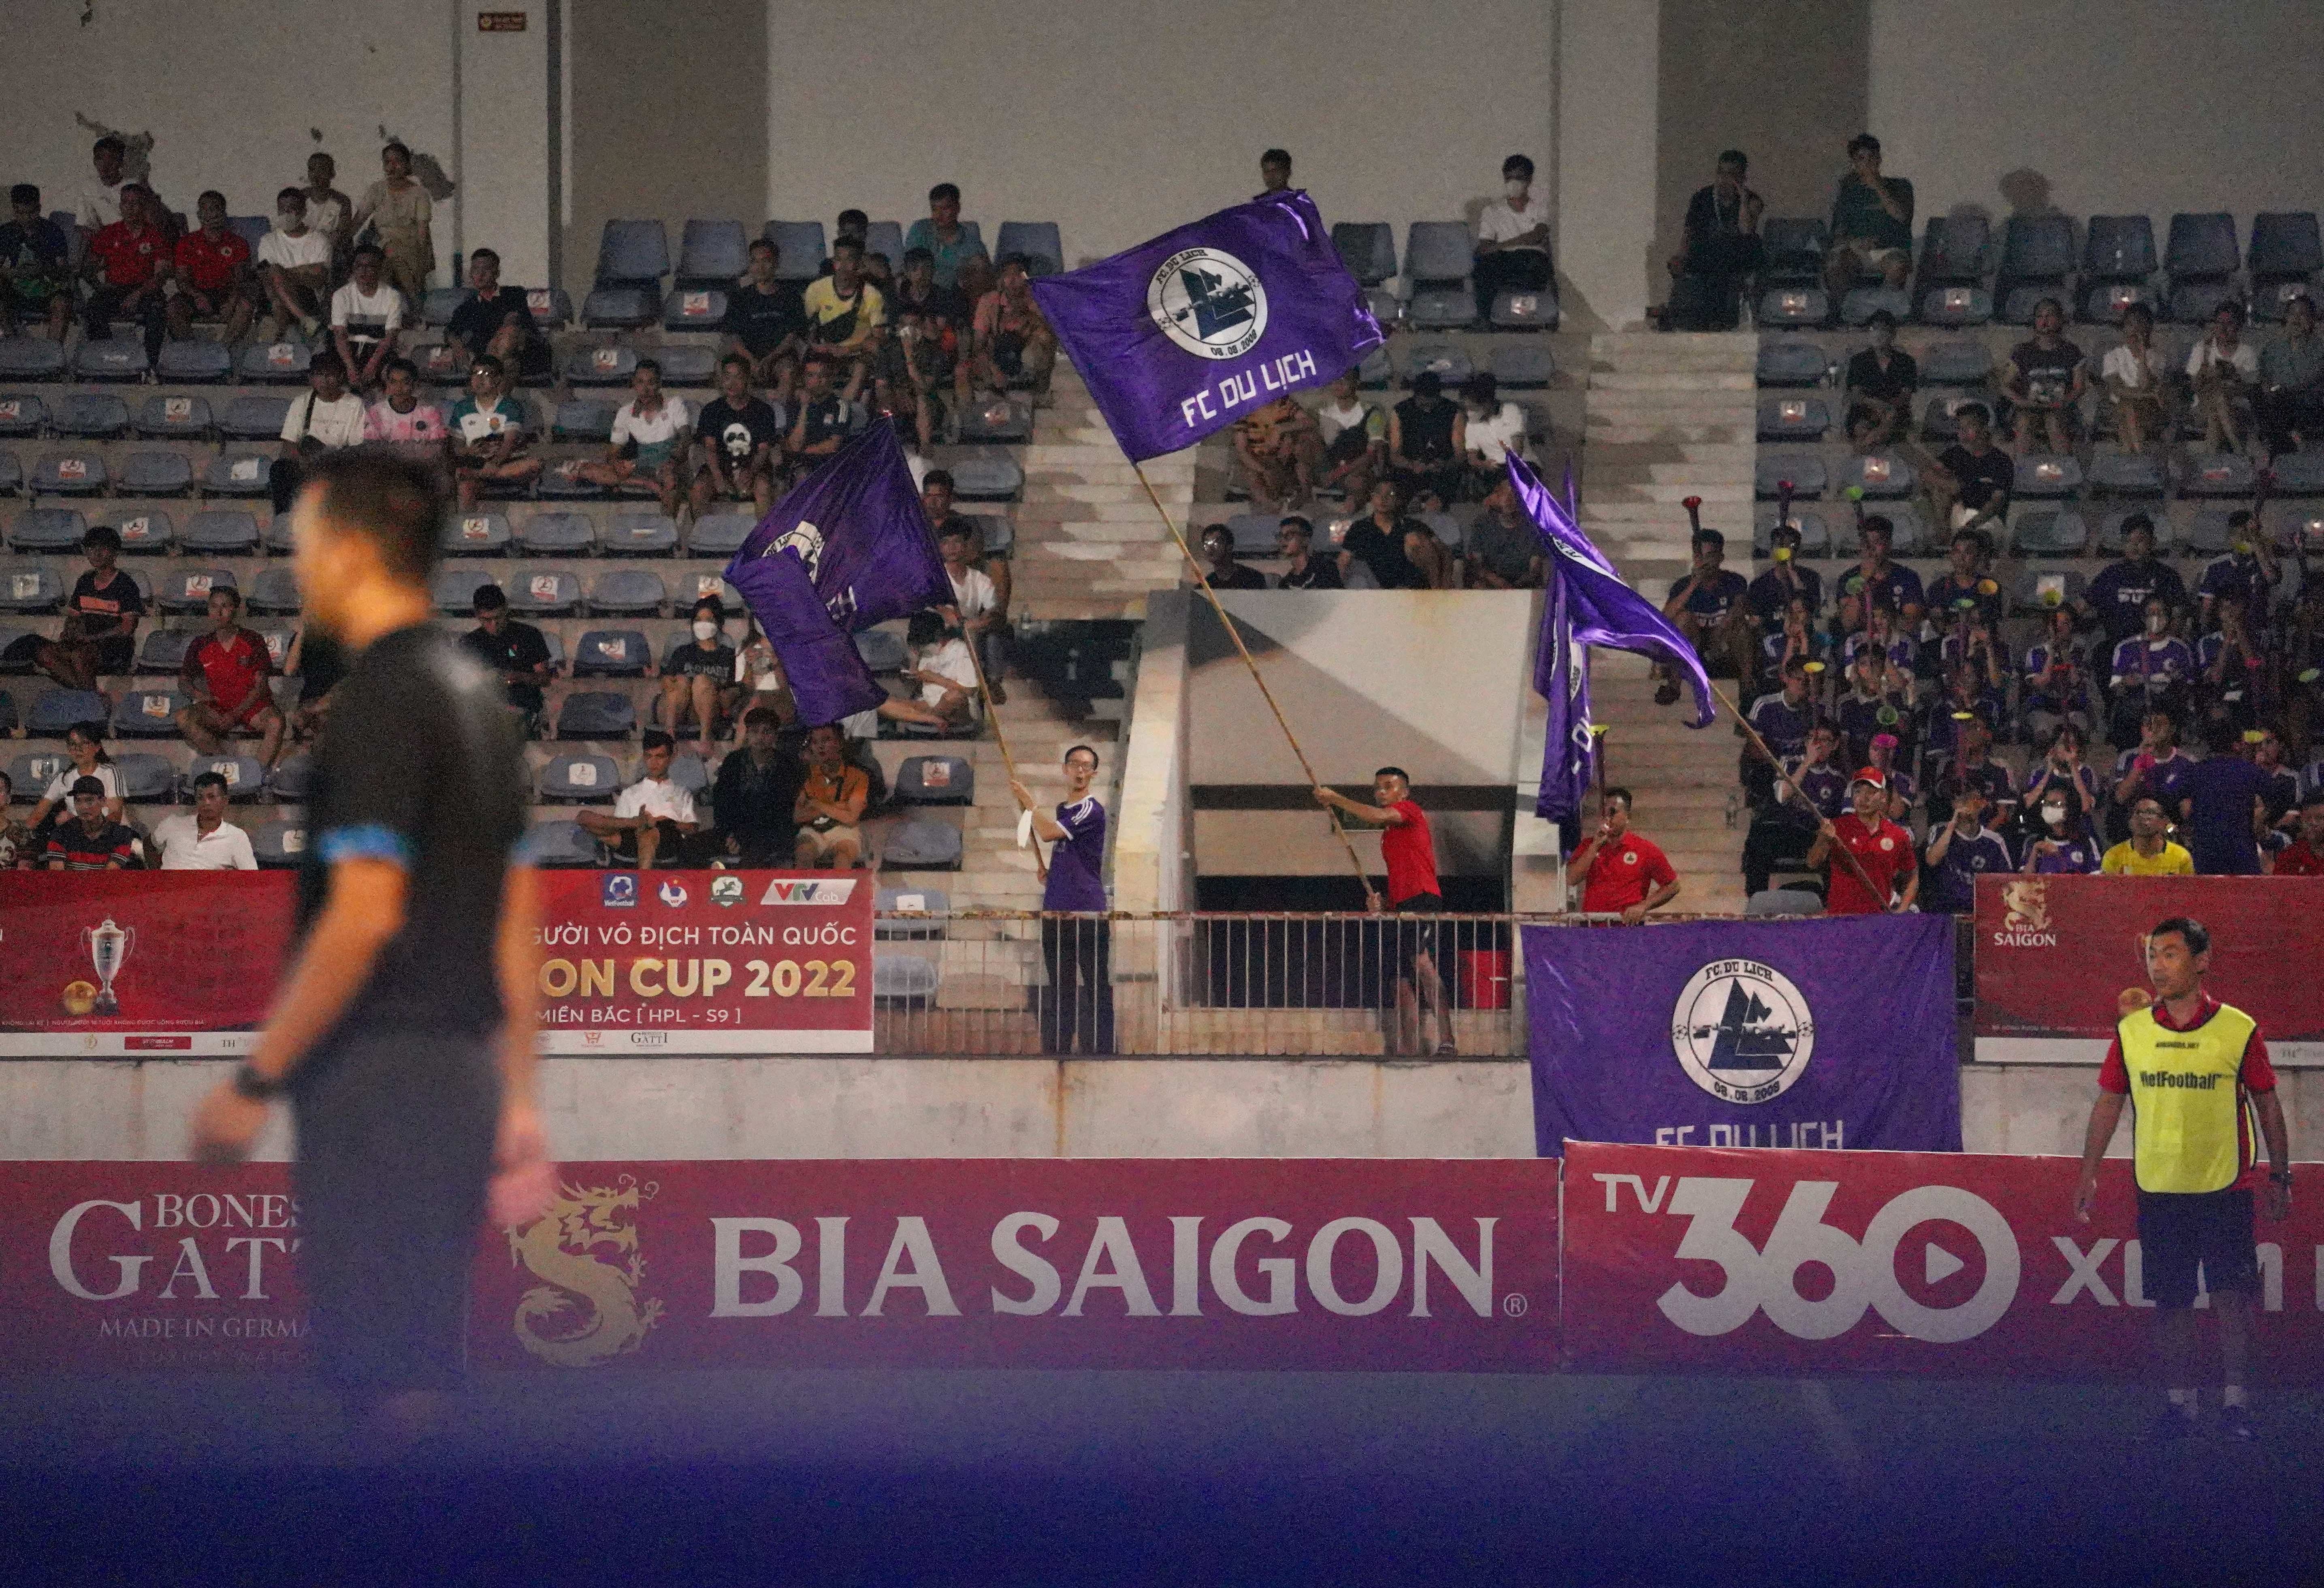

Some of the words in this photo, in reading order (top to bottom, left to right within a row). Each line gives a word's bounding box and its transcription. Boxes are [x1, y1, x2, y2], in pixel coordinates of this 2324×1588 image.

[1180, 389, 1217, 428] FC
[1219, 370, 1256, 409] DU
[1261, 349, 1316, 390] LỊCH
[598, 922, 632, 945] VÔ
[640, 926, 699, 951] ĐỊCH
[709, 921, 773, 945] TOÀN
[783, 921, 856, 945] QUỐC
[1994, 932, 2057, 946] SAIGON
[630, 958, 731, 997] CUP
[744, 959, 855, 997] 2022
[591, 1005, 630, 1023] BẮC
[649, 1009, 686, 1023] HPL
[706, 1009, 728, 1023] S9
[49, 1199, 302, 1300] GAT
[709, 1217, 963, 1318] BIA
[989, 1210, 1500, 1317] SAIGON
[100, 1318, 175, 1337] MADE
[185, 1318, 213, 1337] IN
